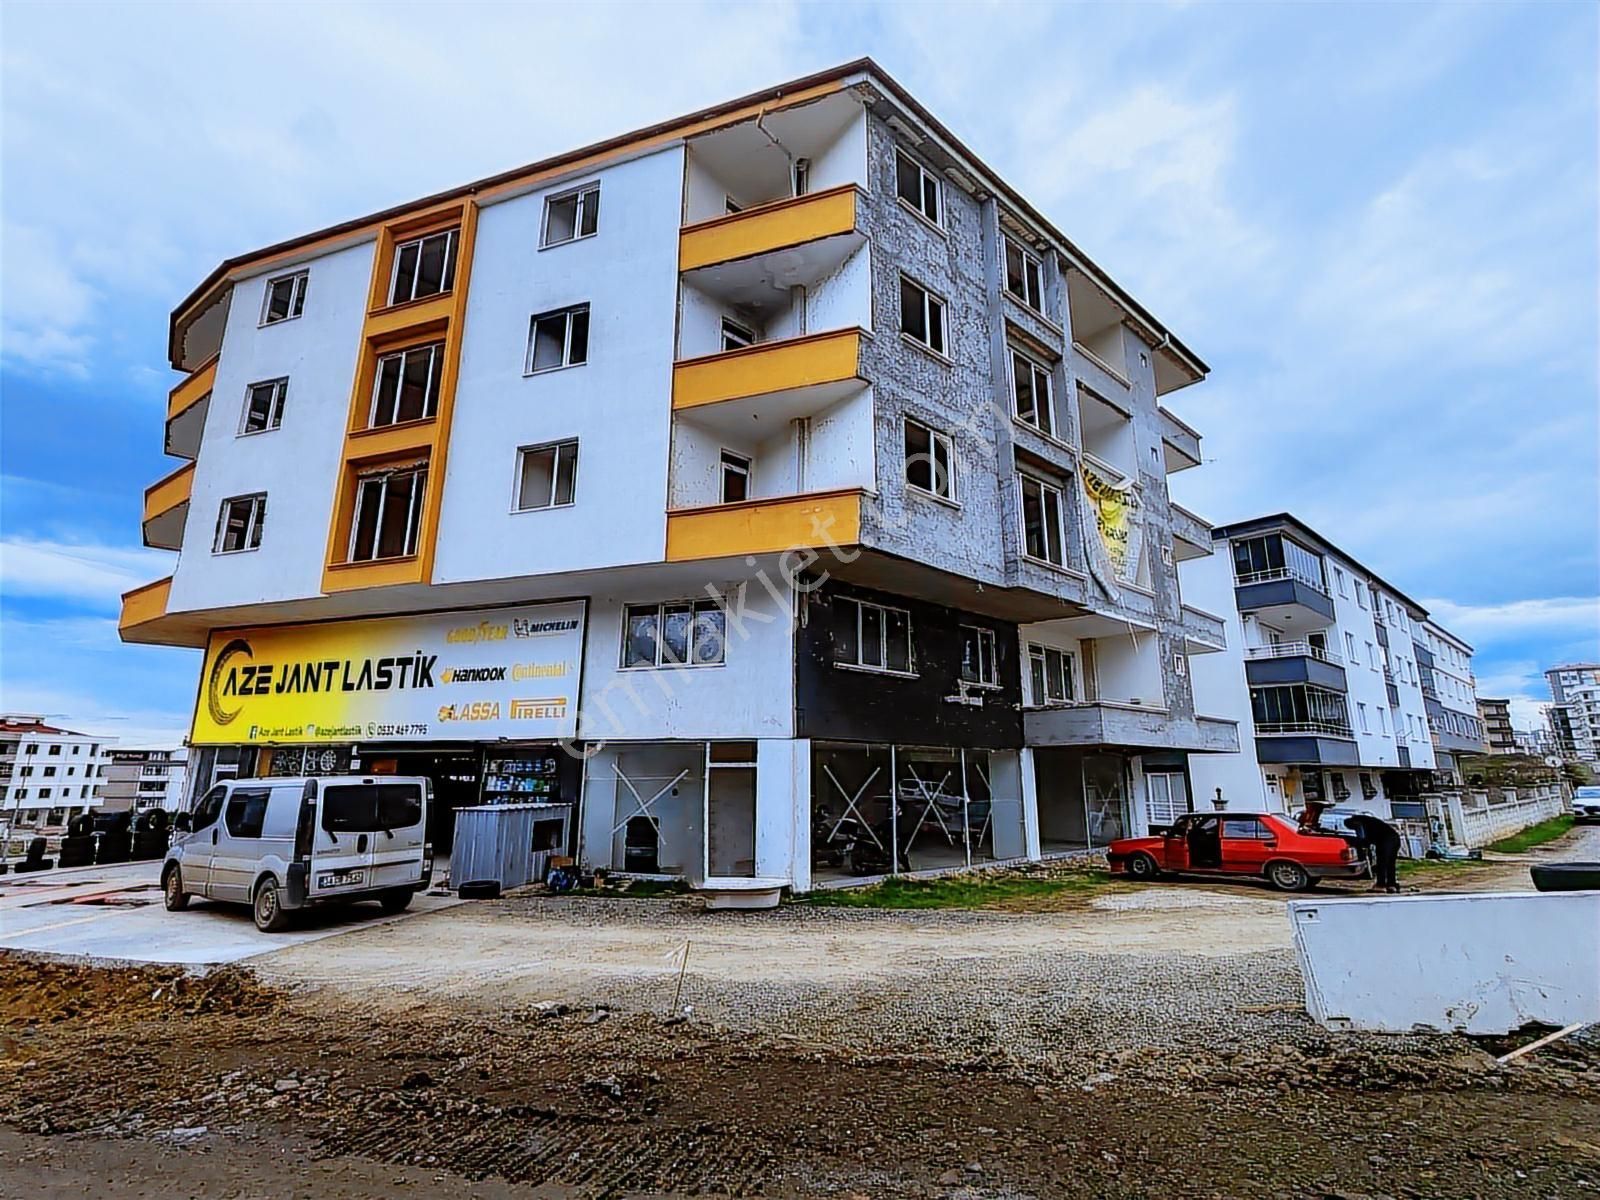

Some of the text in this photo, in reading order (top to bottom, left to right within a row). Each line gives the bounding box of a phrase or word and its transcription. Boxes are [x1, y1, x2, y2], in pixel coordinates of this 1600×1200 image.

[530, 620, 578, 633] MICHELIN
[223, 650, 438, 696] AZE JANT LASTİK
[512, 660, 566, 682] Continental
[453, 702, 499, 720] LASSA
[510, 698, 567, 719] PIRELLI
[285, 726, 303, 736] Lastik
[377, 725, 394, 736] 0532
[410, 724, 428, 735] 7795
